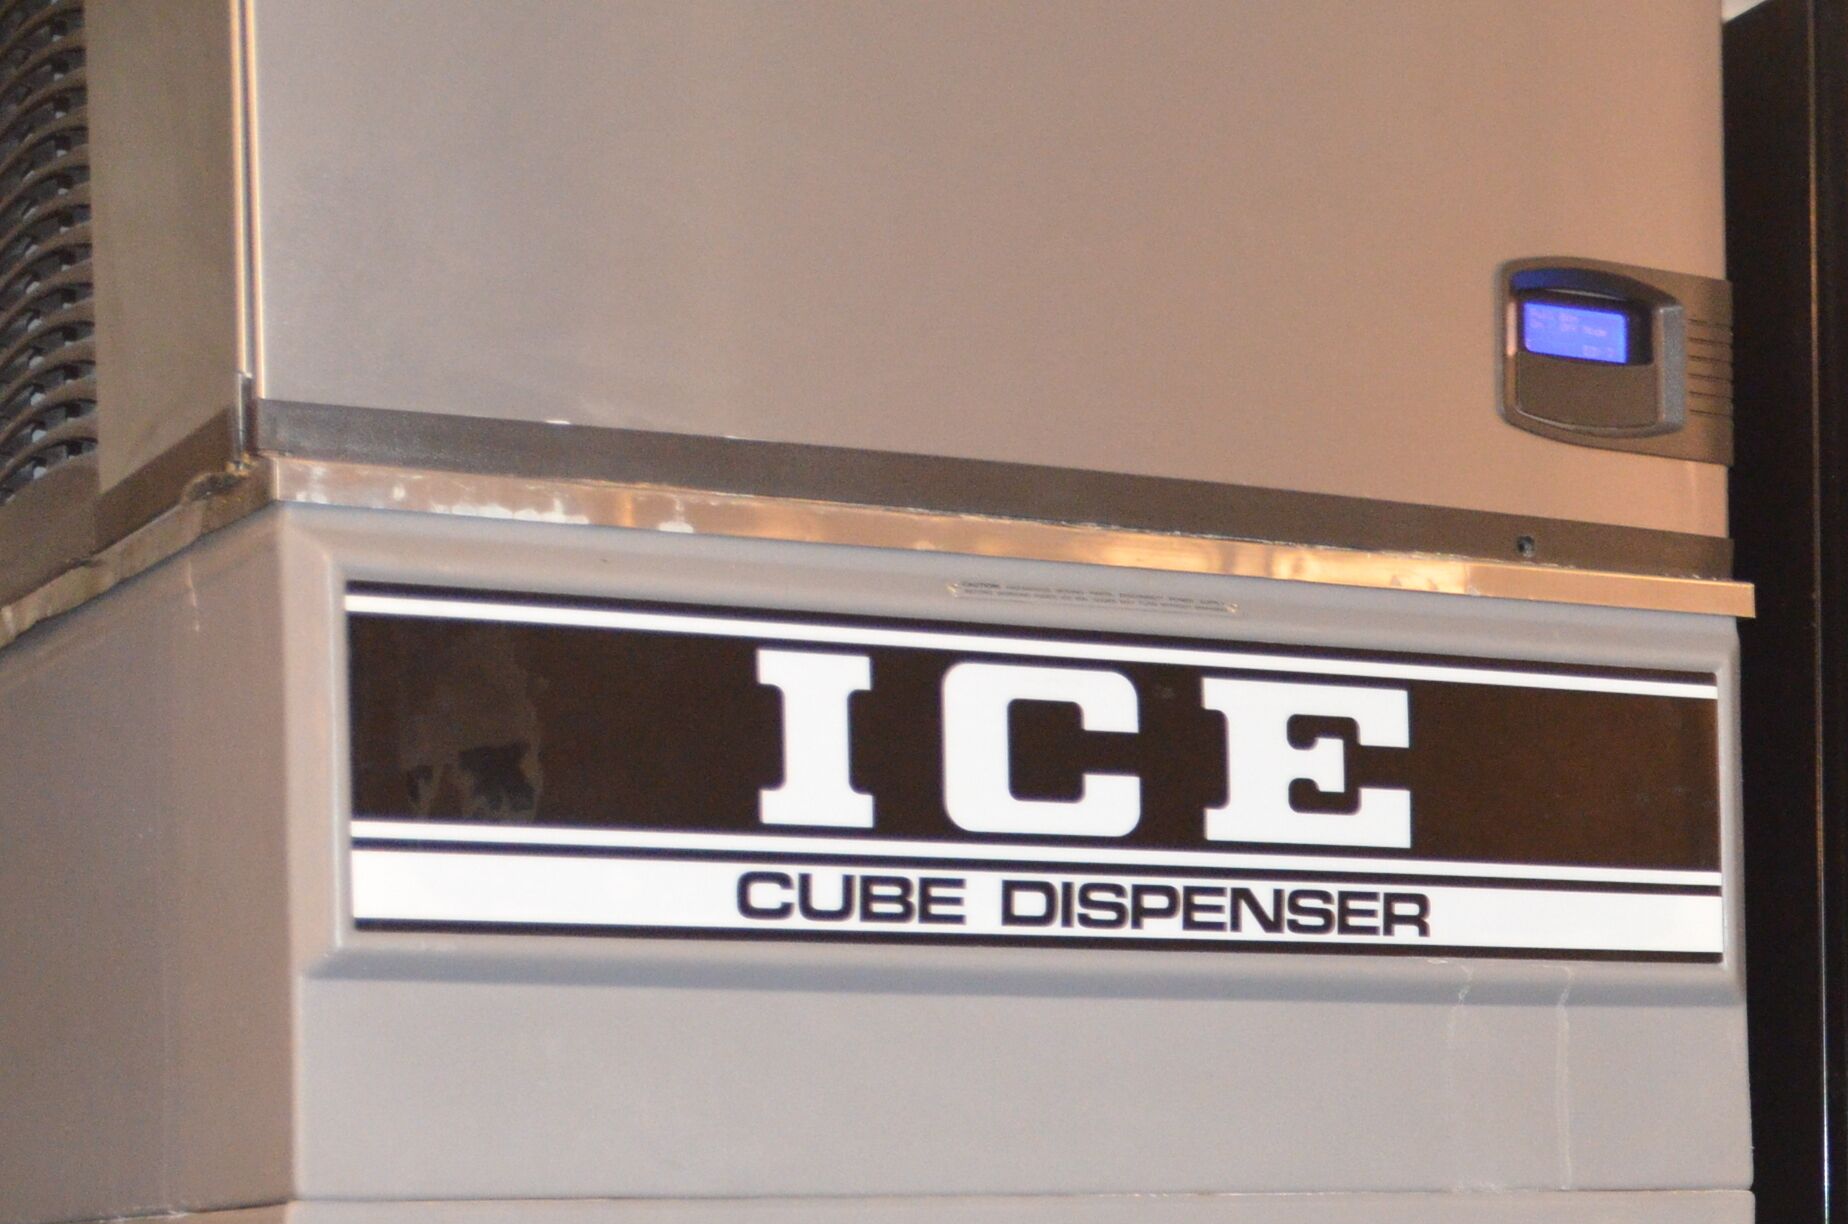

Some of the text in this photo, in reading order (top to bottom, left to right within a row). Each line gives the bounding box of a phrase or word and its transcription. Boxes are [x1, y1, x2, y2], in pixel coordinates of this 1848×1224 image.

[757, 650, 1412, 850] ICE
[736, 868, 1431, 940] CUBE DISPENSER
